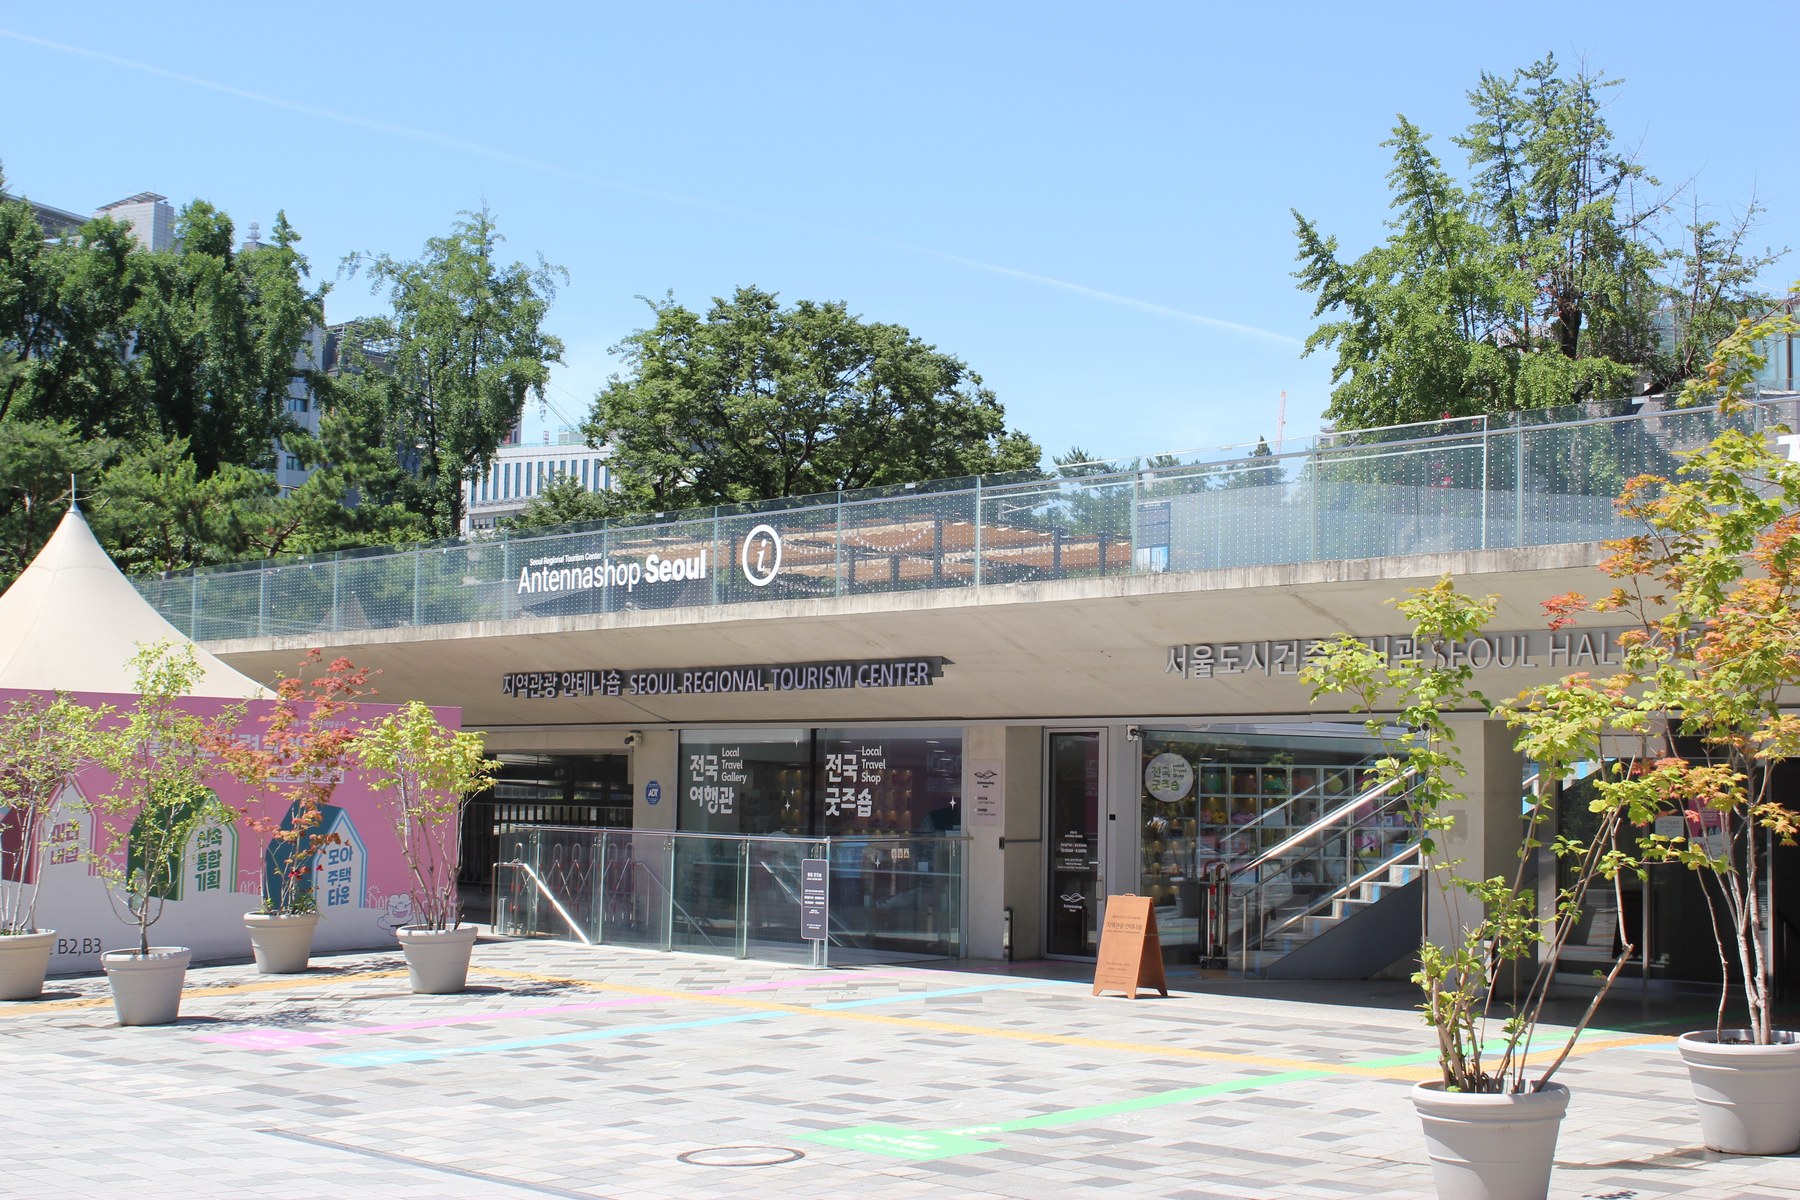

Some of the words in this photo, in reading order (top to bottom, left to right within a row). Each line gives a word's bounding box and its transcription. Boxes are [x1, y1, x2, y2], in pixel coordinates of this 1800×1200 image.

[530, 558, 544, 566] Seoul
[544, 556, 564, 566] Regional
[565, 554, 585, 563] Tourism
[585, 552, 603, 561] Center
[517, 558, 641, 594] Antennashop
[645, 549, 706, 584] Seoul
[1431, 634, 1538, 669] SEOUL
[502, 672, 558, 698] 지역관광
[562, 670, 621, 697] 안테나숍
[630, 674, 679, 695] SEOUL
[683, 669, 765, 693] REGIONAL
[771, 665, 851, 690] TOURISM
[858, 662, 930, 687] CENTER
[721, 747, 740, 757] Local
[861, 745, 882, 756] Local
[690, 754, 719, 781] 전국
[721, 759, 743, 770] Travel
[825, 753, 858, 783] 전국
[861, 759, 886, 770] Travel
[721, 773, 747, 784] Gallery
[861, 772, 882, 785] Shop
[648, 788, 659, 797] ADT
[689, 786, 735, 814] 여행관
[825, 787, 873, 817] 굿즈숍
[197, 850, 222, 871] 통합
[328, 846, 353, 866] 모아
[195, 870, 220, 891] 기획
[328, 867, 352, 886] 주택
[328, 885, 350, 906] 타운
[58, 938, 102, 956] B2,B3
